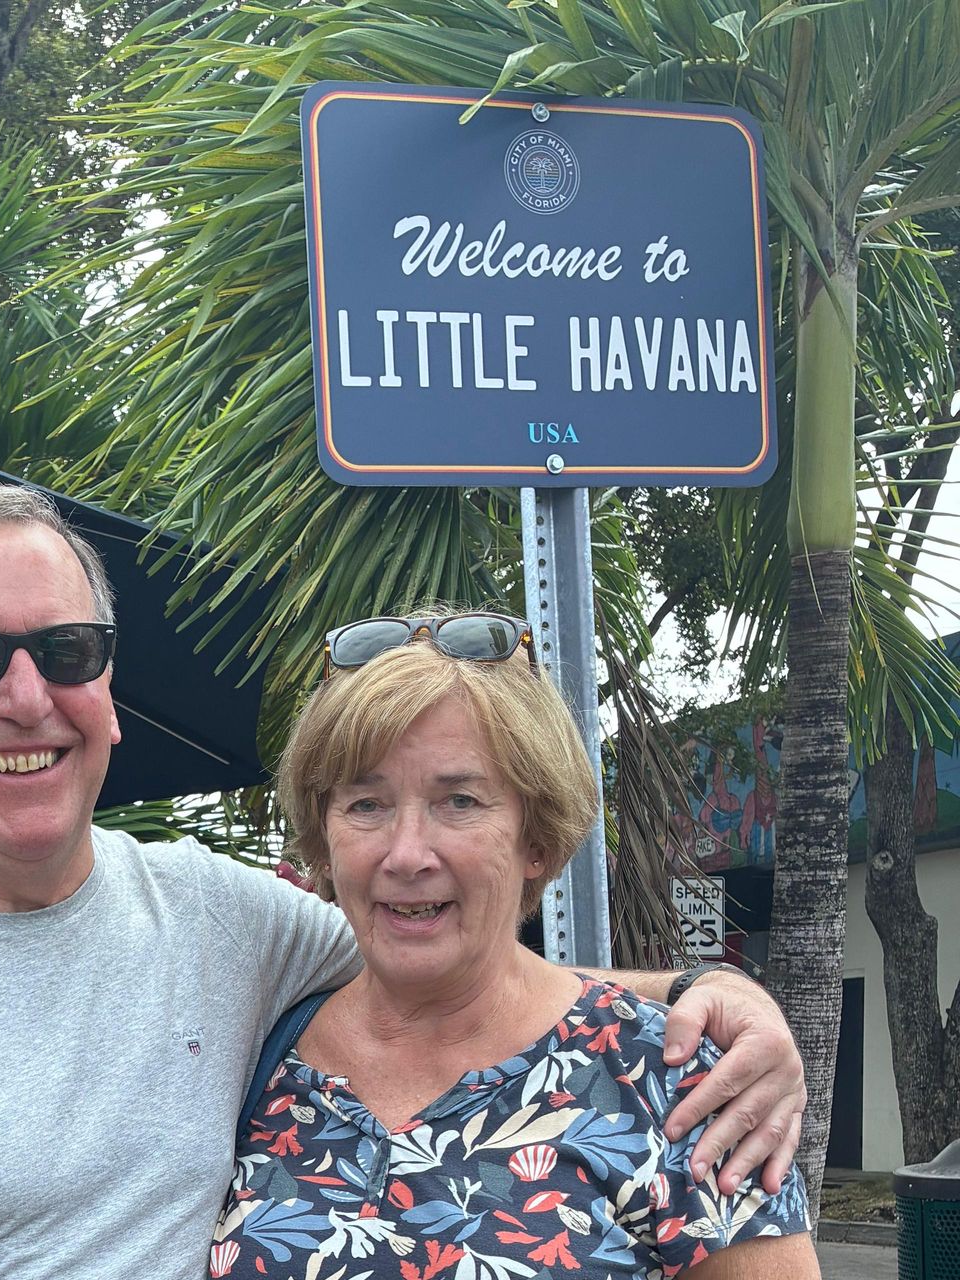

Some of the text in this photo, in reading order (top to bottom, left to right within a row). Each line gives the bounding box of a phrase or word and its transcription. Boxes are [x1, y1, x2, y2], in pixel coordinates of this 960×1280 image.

[511, 136, 573, 167] CITY OF MIAMI
[522, 192, 566, 208] FLORIDA
[392, 214, 690, 283] Welcome to
[337, 309, 758, 393] LITTLE HAVANA
[527, 421, 580, 445] USA
[676, 887, 720, 900] SPEED
[680, 903, 715, 916] LIMIT
[679, 919, 718, 947] 25
[171, 1026, 206, 1041] GANT
